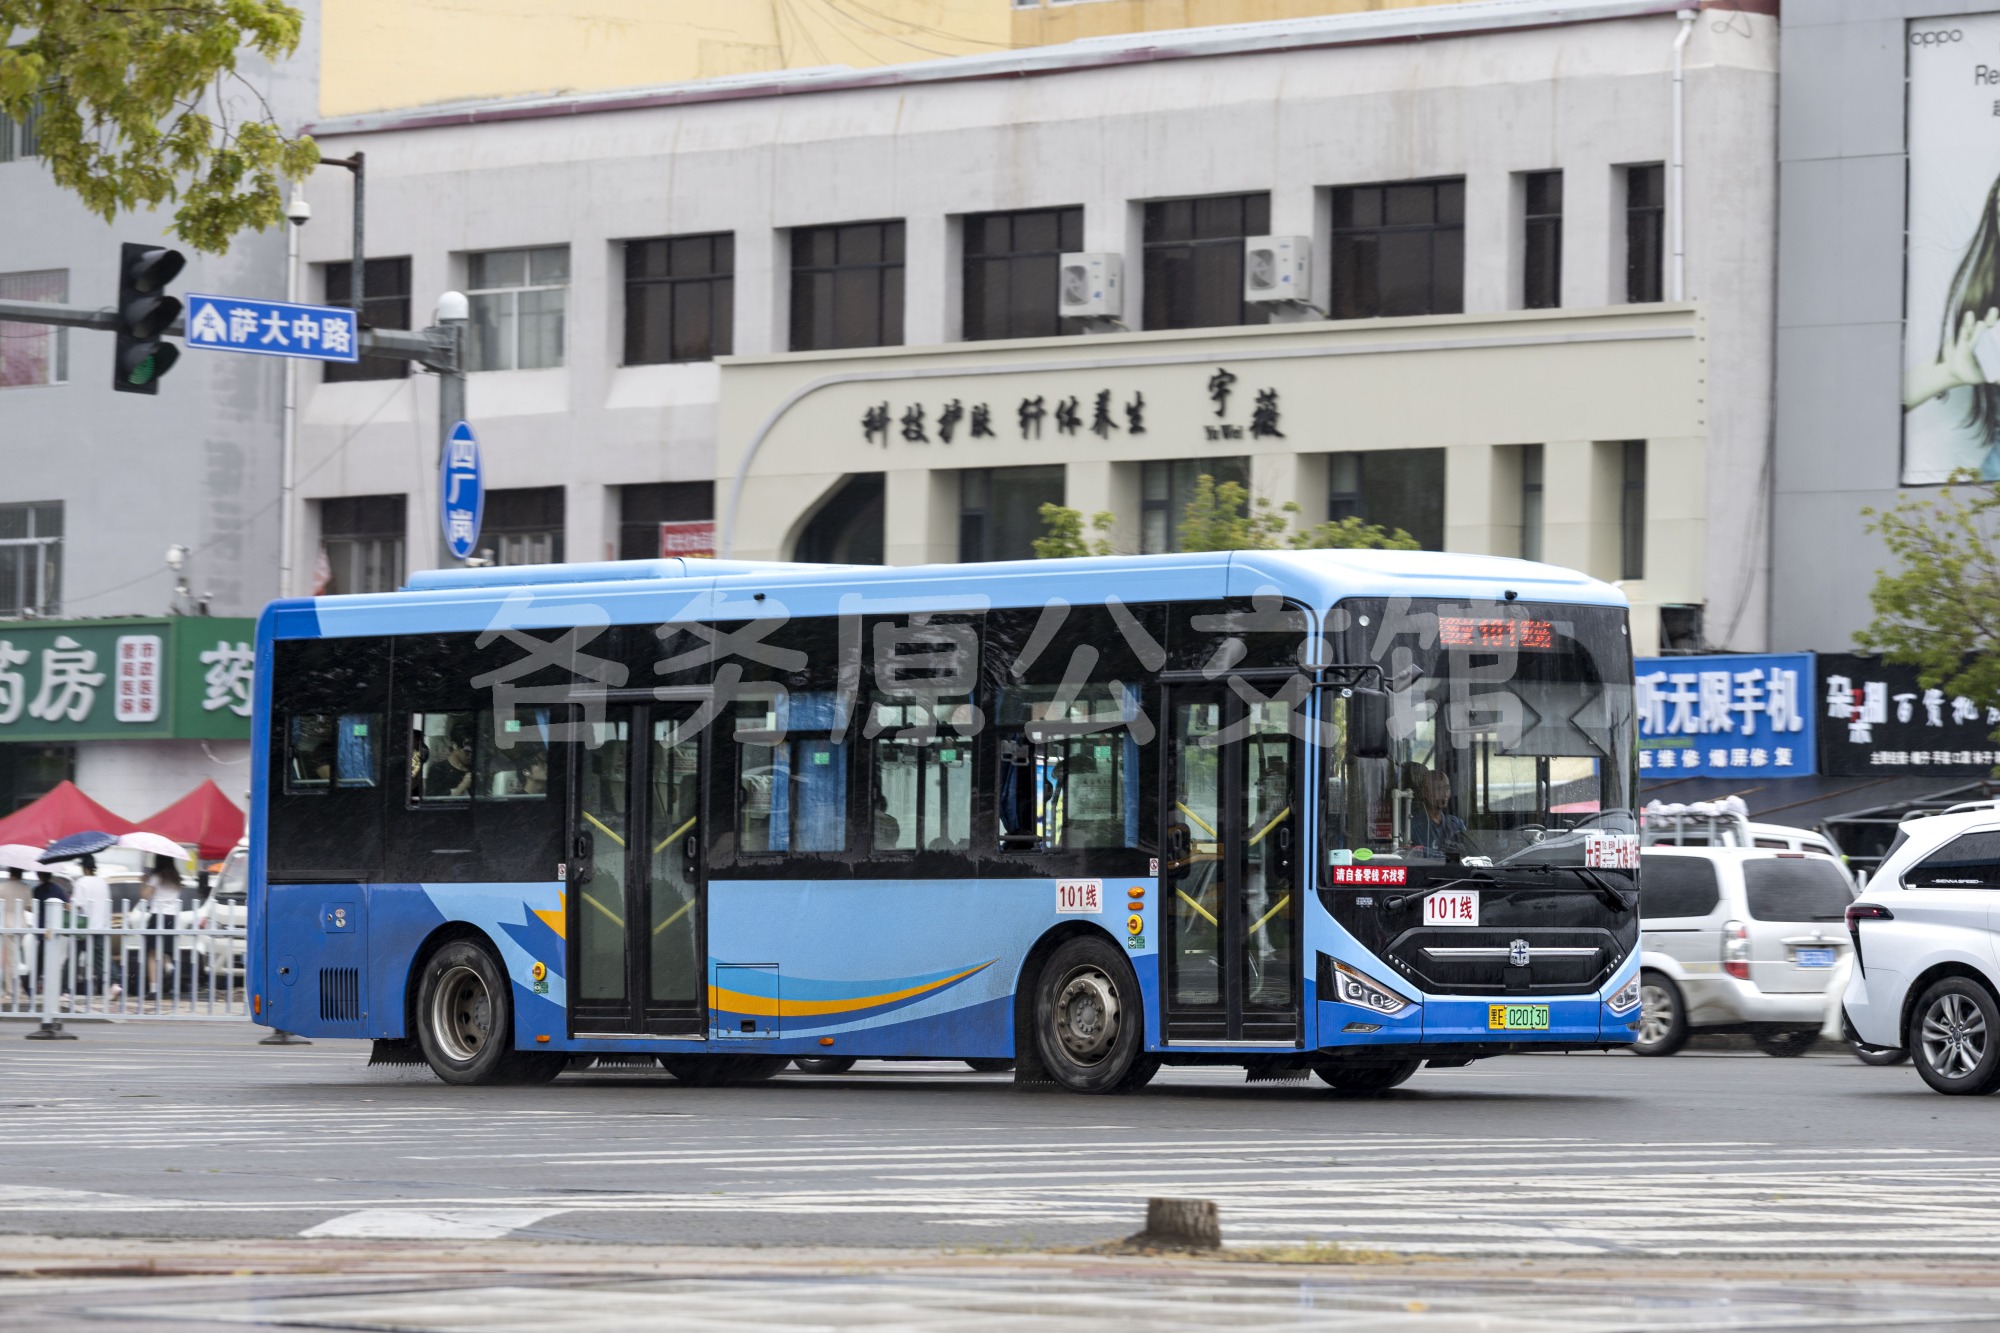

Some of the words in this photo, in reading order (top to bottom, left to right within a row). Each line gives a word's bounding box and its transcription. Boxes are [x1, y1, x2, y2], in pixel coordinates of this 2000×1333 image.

[229, 307, 351, 353] 萨大中路
[862, 398, 997, 449] 科技护肤
[1017, 387, 1148, 440] 纤体养生
[199, 640, 256, 717] 药
[1336, 868, 1380, 882] 请自备零钱
[1381, 869, 1405, 882] 不找零
[1060, 884, 1097, 908] 101线
[1429, 896, 1473, 920] 101线
